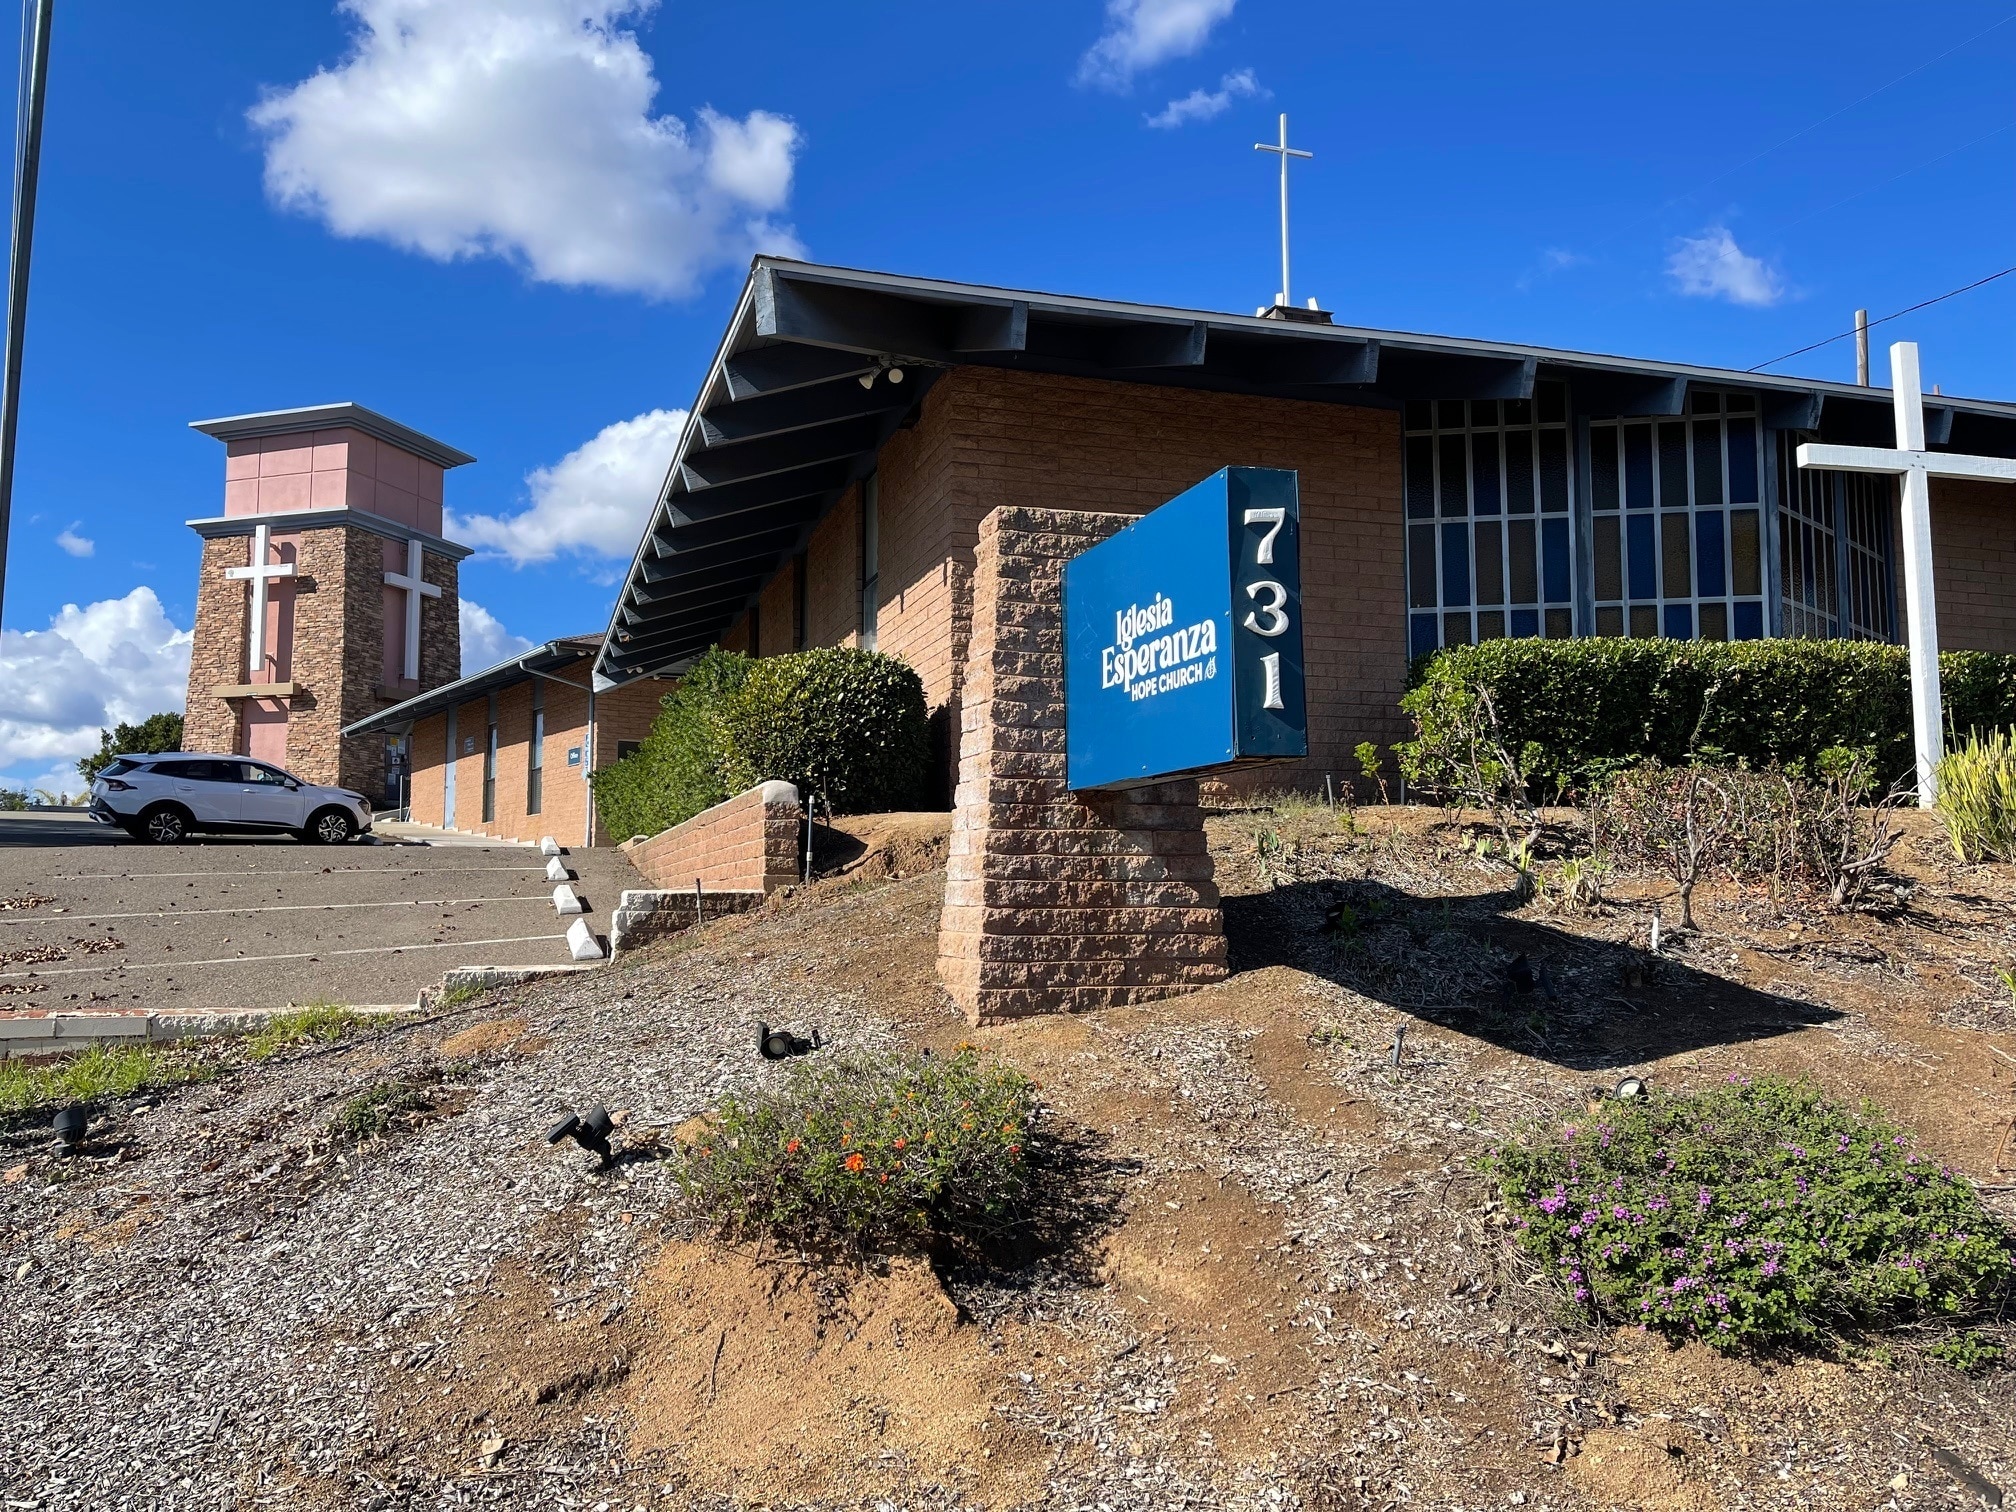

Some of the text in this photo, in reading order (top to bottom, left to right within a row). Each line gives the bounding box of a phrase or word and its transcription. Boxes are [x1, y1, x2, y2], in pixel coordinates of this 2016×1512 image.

[1116, 591, 1173, 652] Iglesia
[1243, 507, 1290, 709] 731
[1101, 619, 1217, 693] Esperanza
[1131, 662, 1203, 702] HOPE CHURCH
